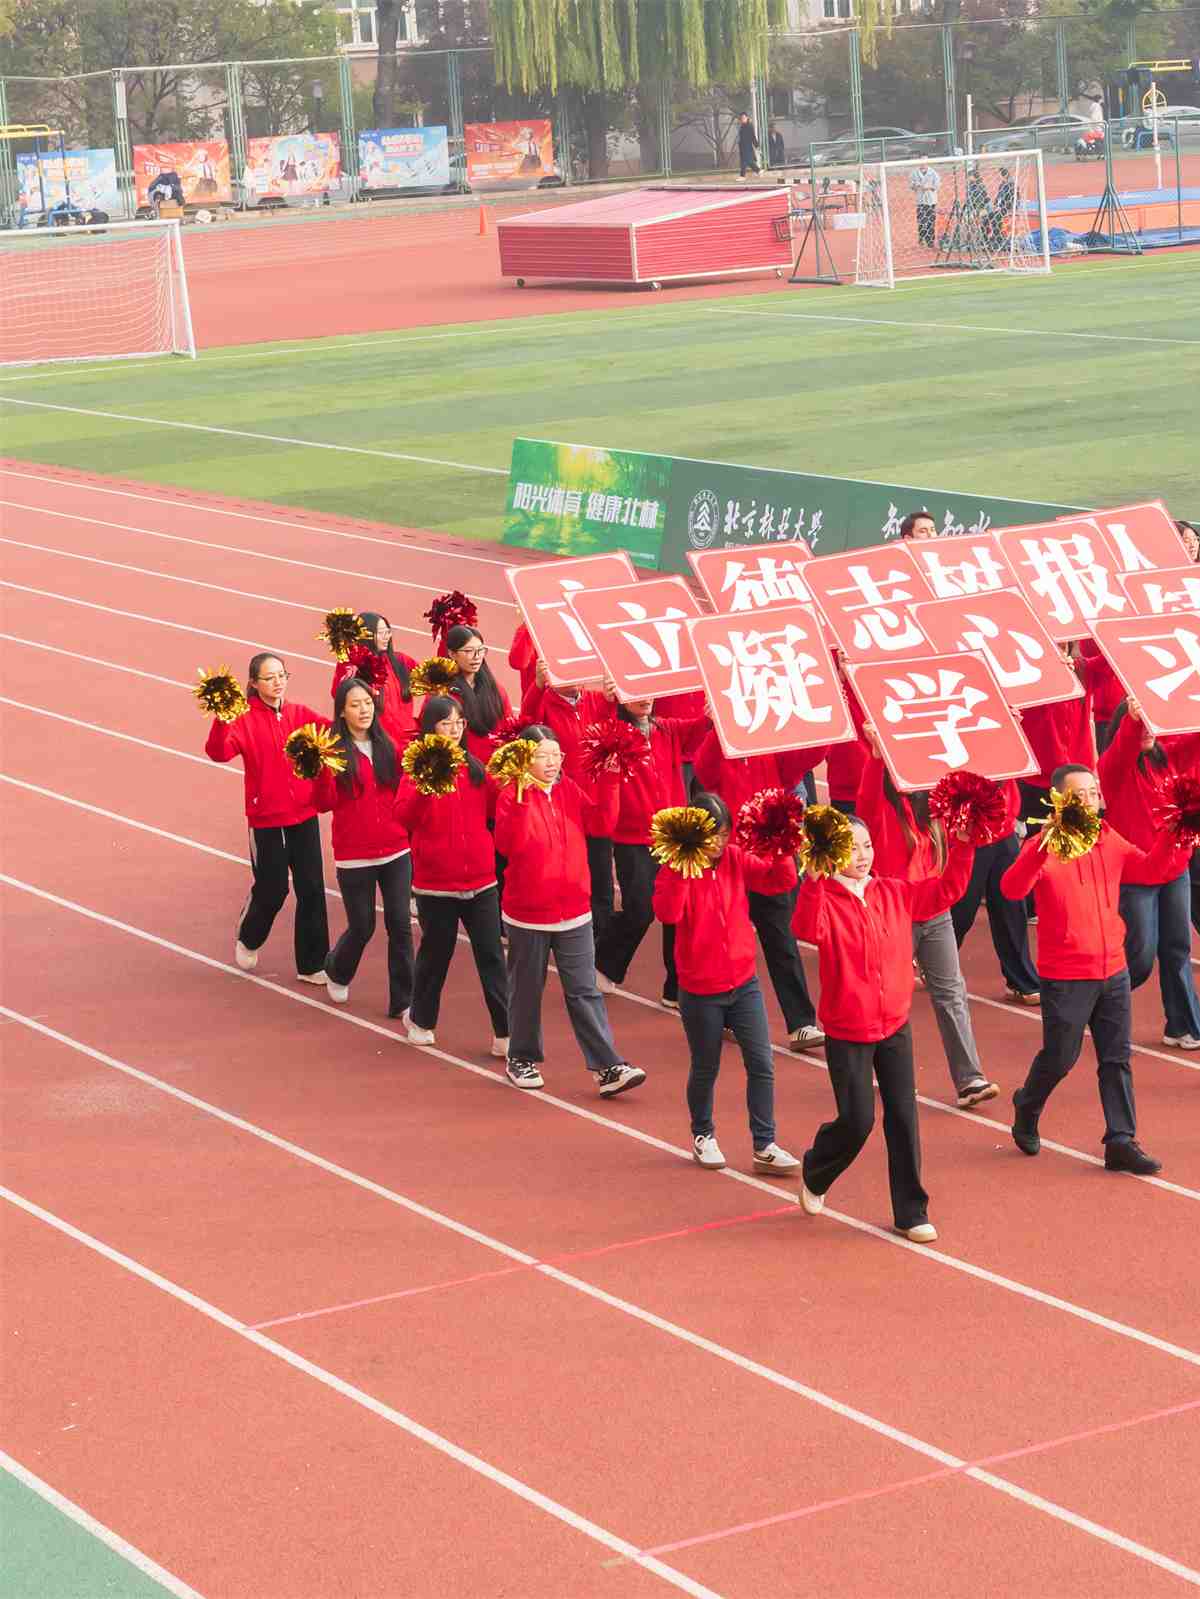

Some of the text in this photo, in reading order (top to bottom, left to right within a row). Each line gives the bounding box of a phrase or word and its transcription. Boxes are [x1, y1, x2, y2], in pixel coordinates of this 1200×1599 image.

[513, 482, 582, 518] 阳光体育
[586, 492, 660, 529] 健康北林
[825, 565, 925, 651] 志
[1019, 534, 1127, 624] 报
[597, 601, 697, 681] 立
[708, 624, 832, 734] 凝
[956, 613, 1044, 688] 心
[883, 669, 1002, 769] 学
